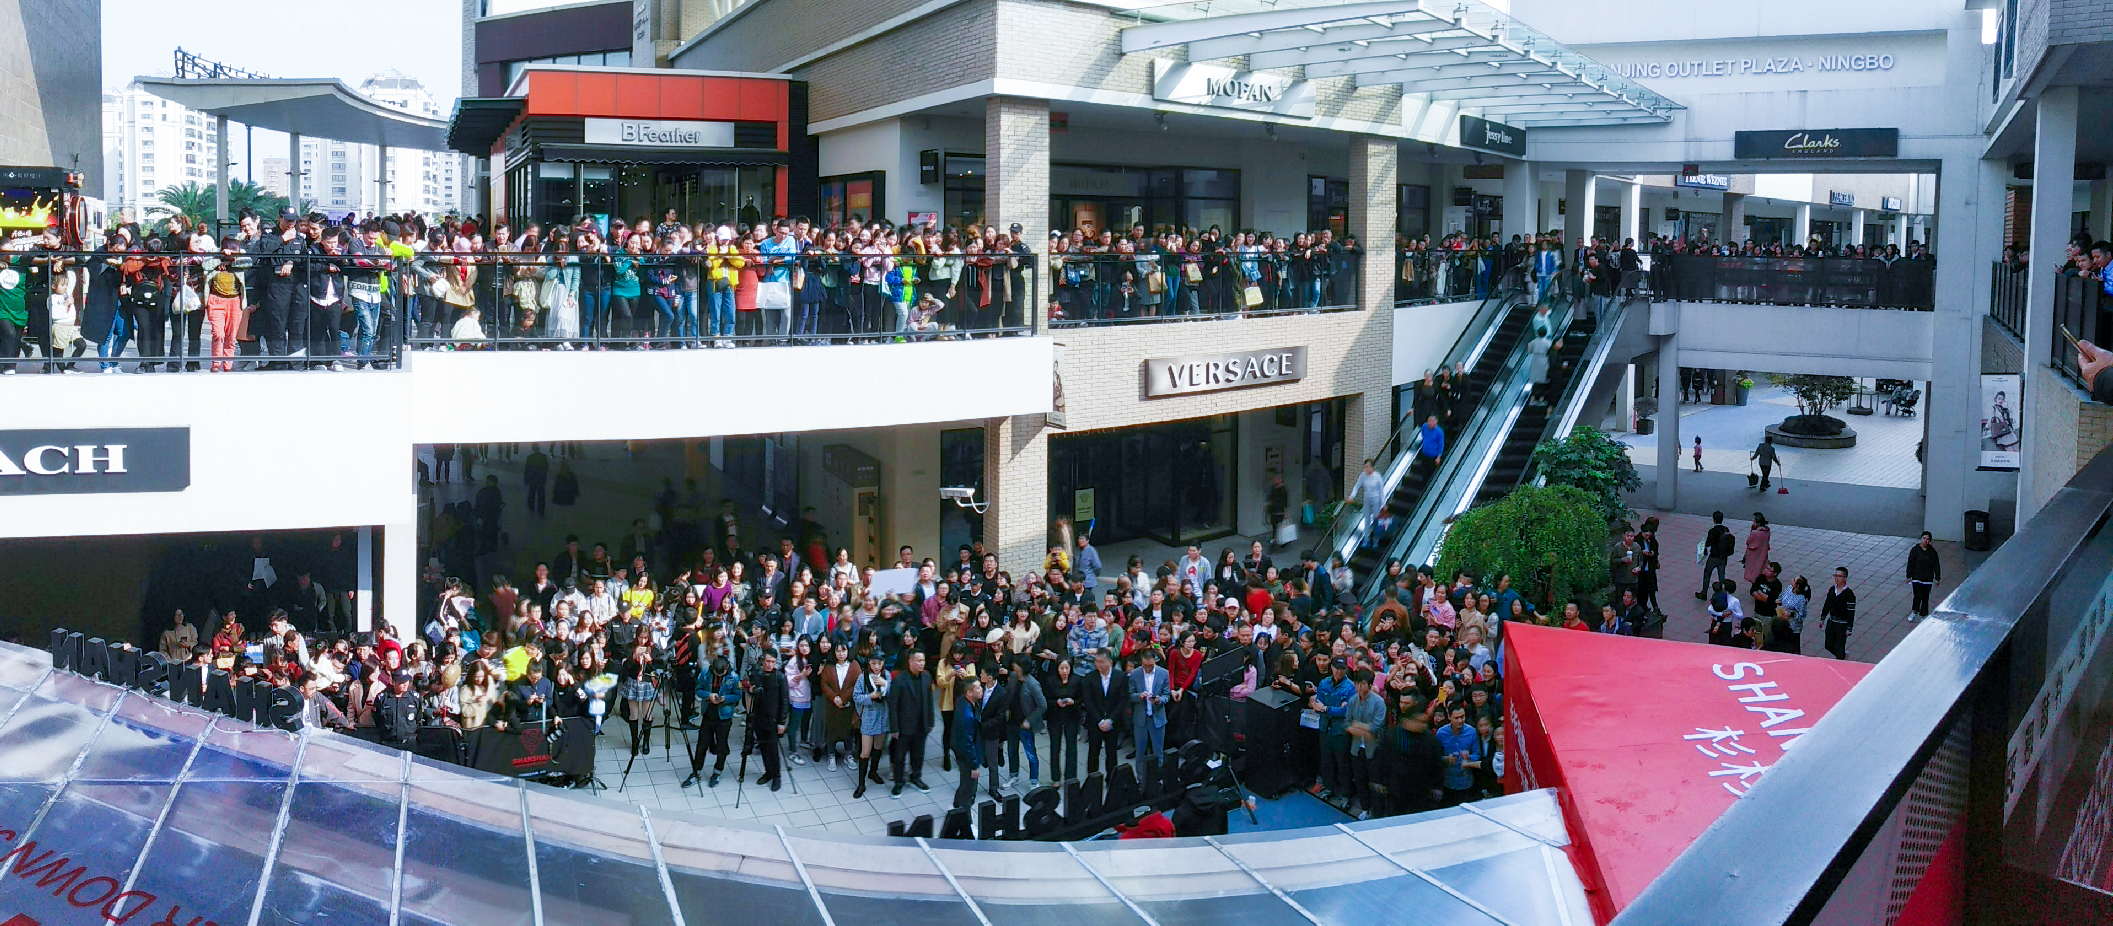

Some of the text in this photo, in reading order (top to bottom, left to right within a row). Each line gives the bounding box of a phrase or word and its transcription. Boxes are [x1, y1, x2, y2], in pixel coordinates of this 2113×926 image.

[1665, 59, 1736, 78] OUTLET
[1740, 55, 1803, 75] PLAZA
[1818, 54, 1895, 72] NINGBO
[1206, 77, 1272, 103] MOFAN
[1784, 132, 1840, 149] Clarks
[1167, 352, 1294, 389] VERSACE
